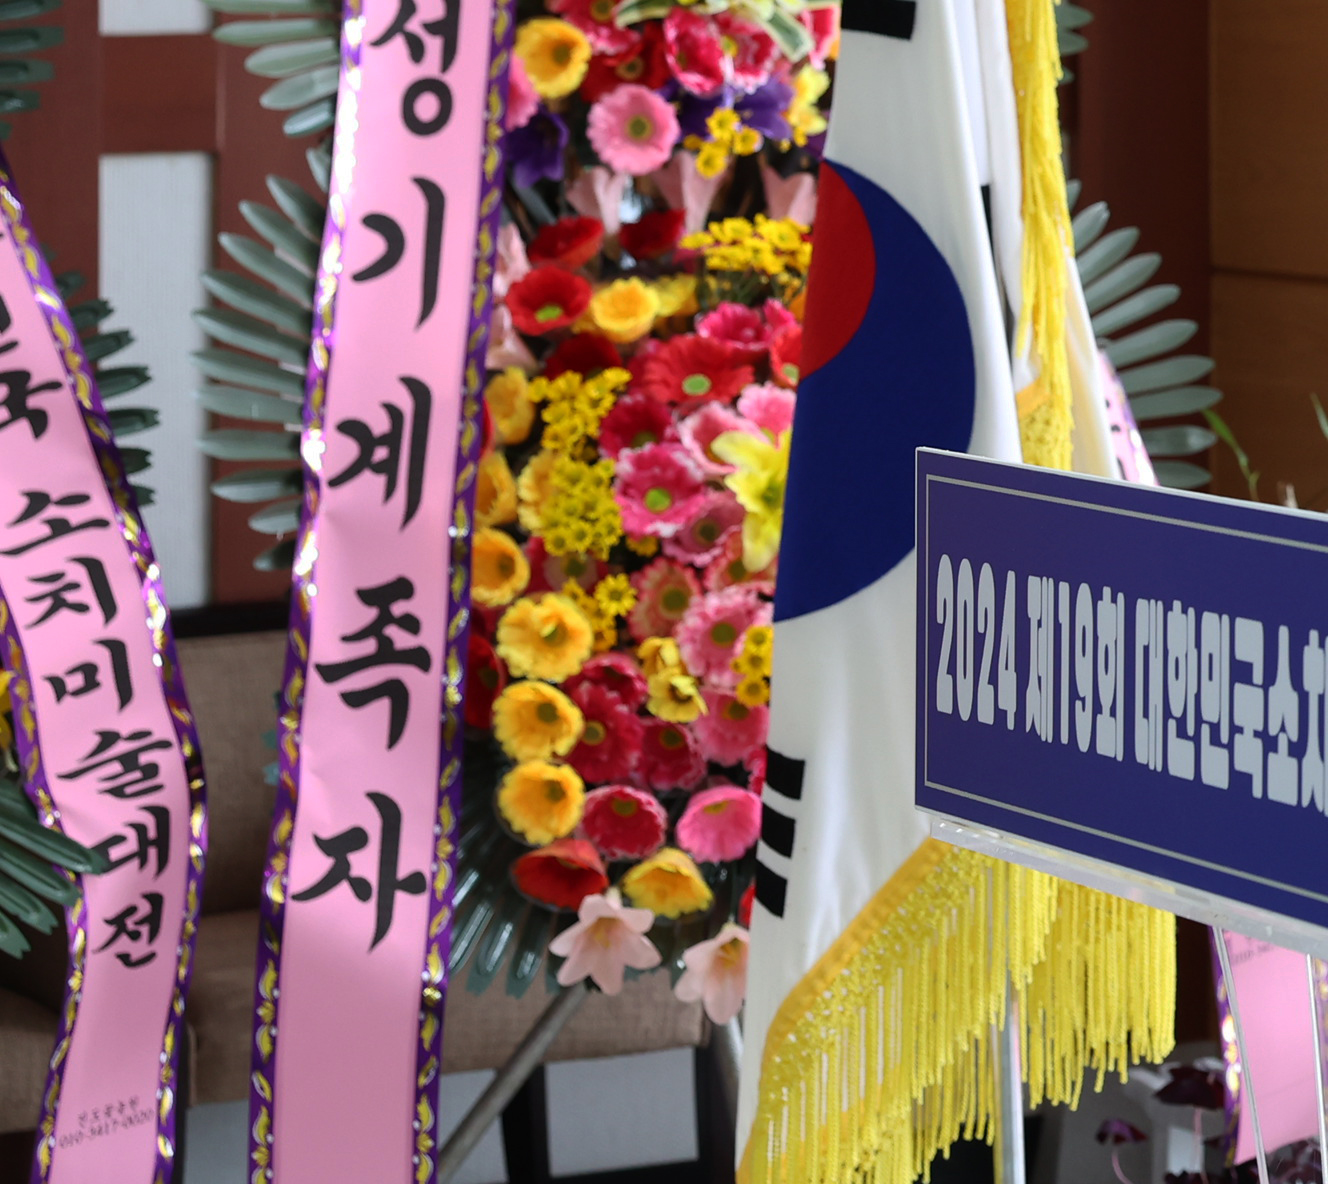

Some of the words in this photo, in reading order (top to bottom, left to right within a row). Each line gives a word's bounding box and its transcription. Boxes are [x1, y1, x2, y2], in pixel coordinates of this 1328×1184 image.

[0, 486, 174, 969] 소치미술대전
[936, 553, 1017, 731] 2024
[1025, 574, 1126, 762] 제19회
